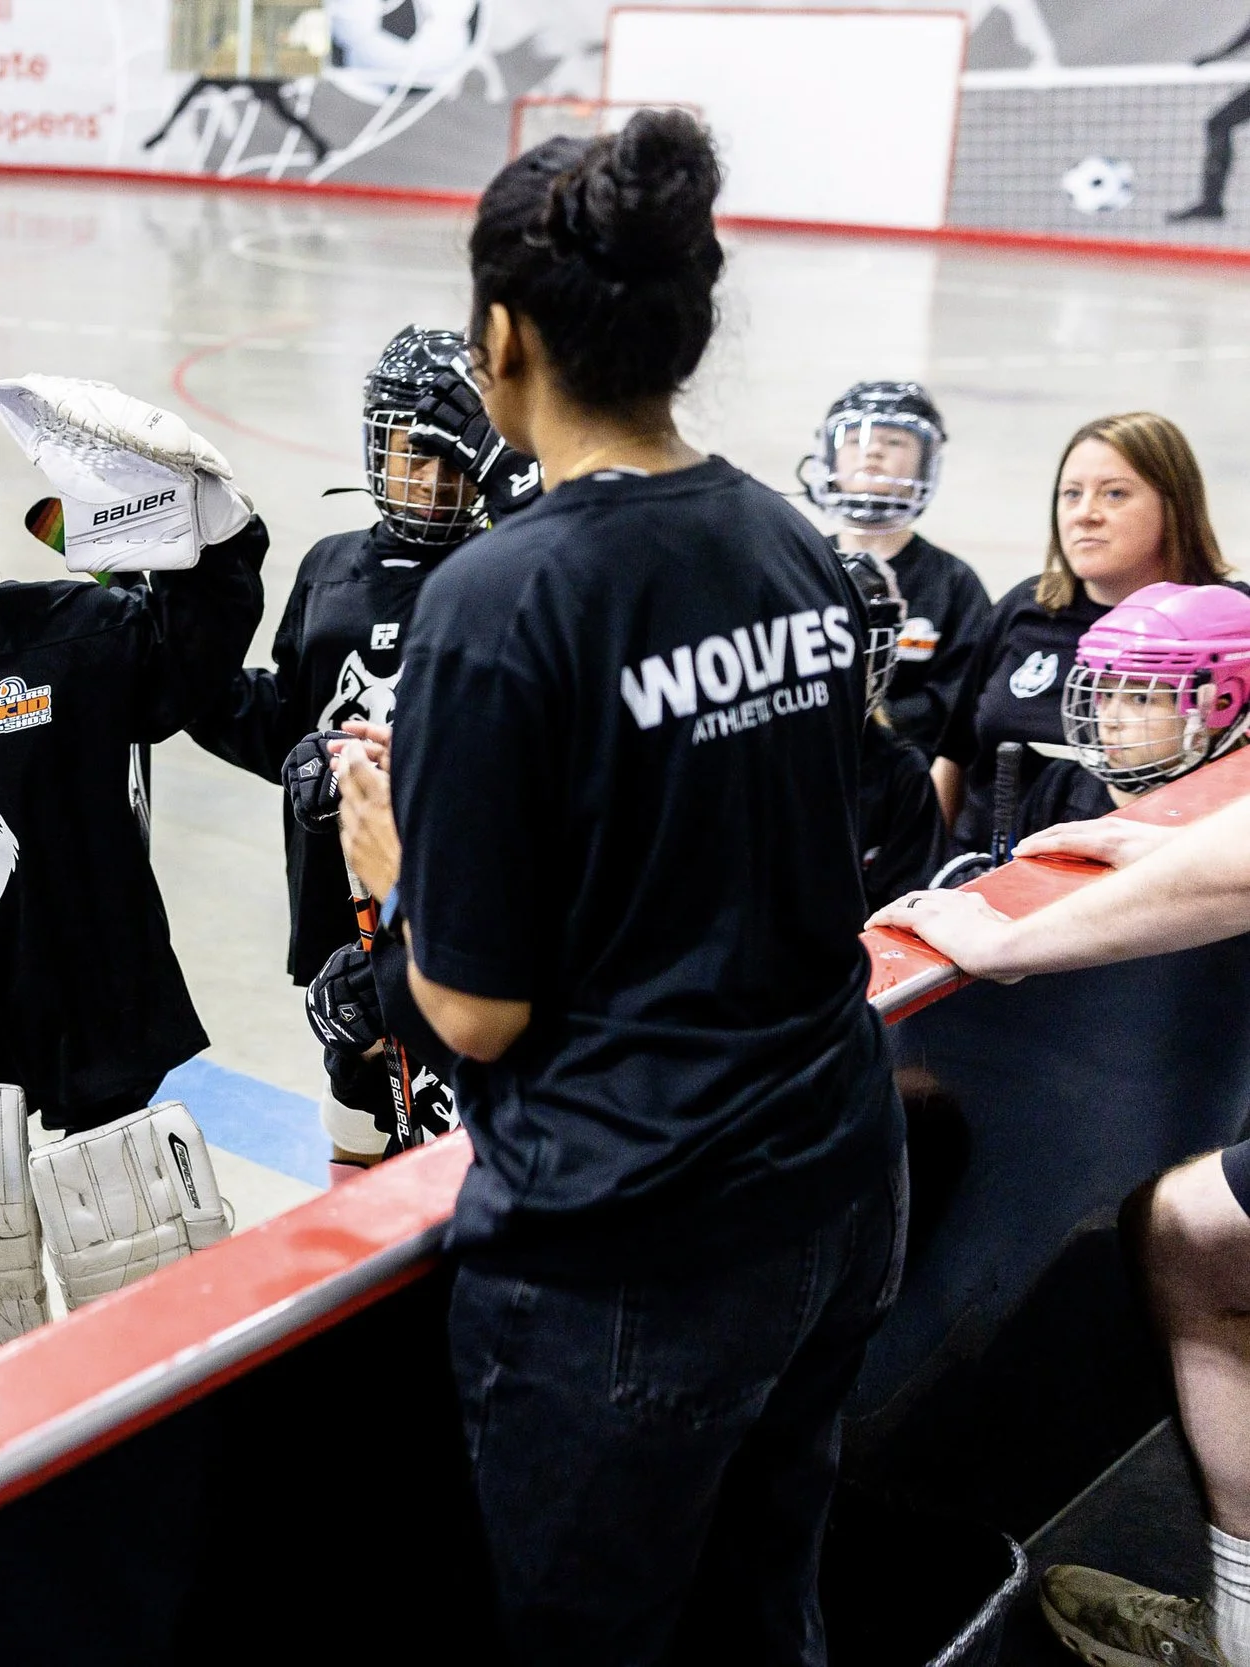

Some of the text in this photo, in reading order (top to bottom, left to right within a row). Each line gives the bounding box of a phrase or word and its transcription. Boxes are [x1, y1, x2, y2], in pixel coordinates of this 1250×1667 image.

[93, 489, 177, 526] BAUER
[619, 604, 856, 731] WOLVES
[772, 679, 830, 716] CLUB
[389, 1075, 410, 1143] BAUER
[176, 1143, 202, 1210] REACTOR
